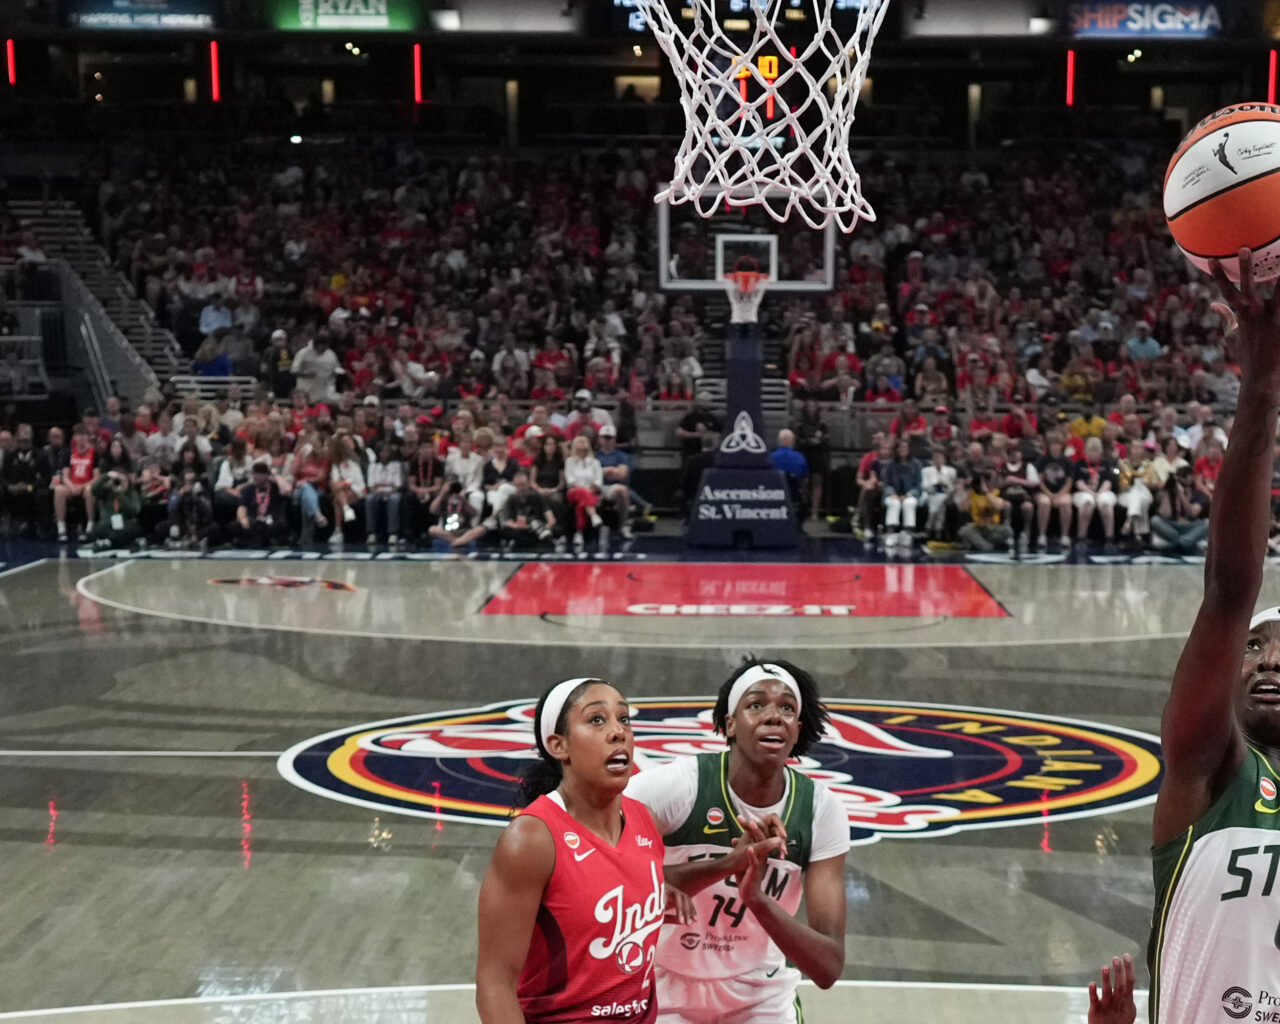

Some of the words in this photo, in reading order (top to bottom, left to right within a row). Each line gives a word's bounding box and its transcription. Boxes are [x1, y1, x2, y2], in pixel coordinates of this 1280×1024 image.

[700, 485, 785, 500] Ascension
[722, 504, 788, 519] Vincent
[708, 893, 747, 928] 14
